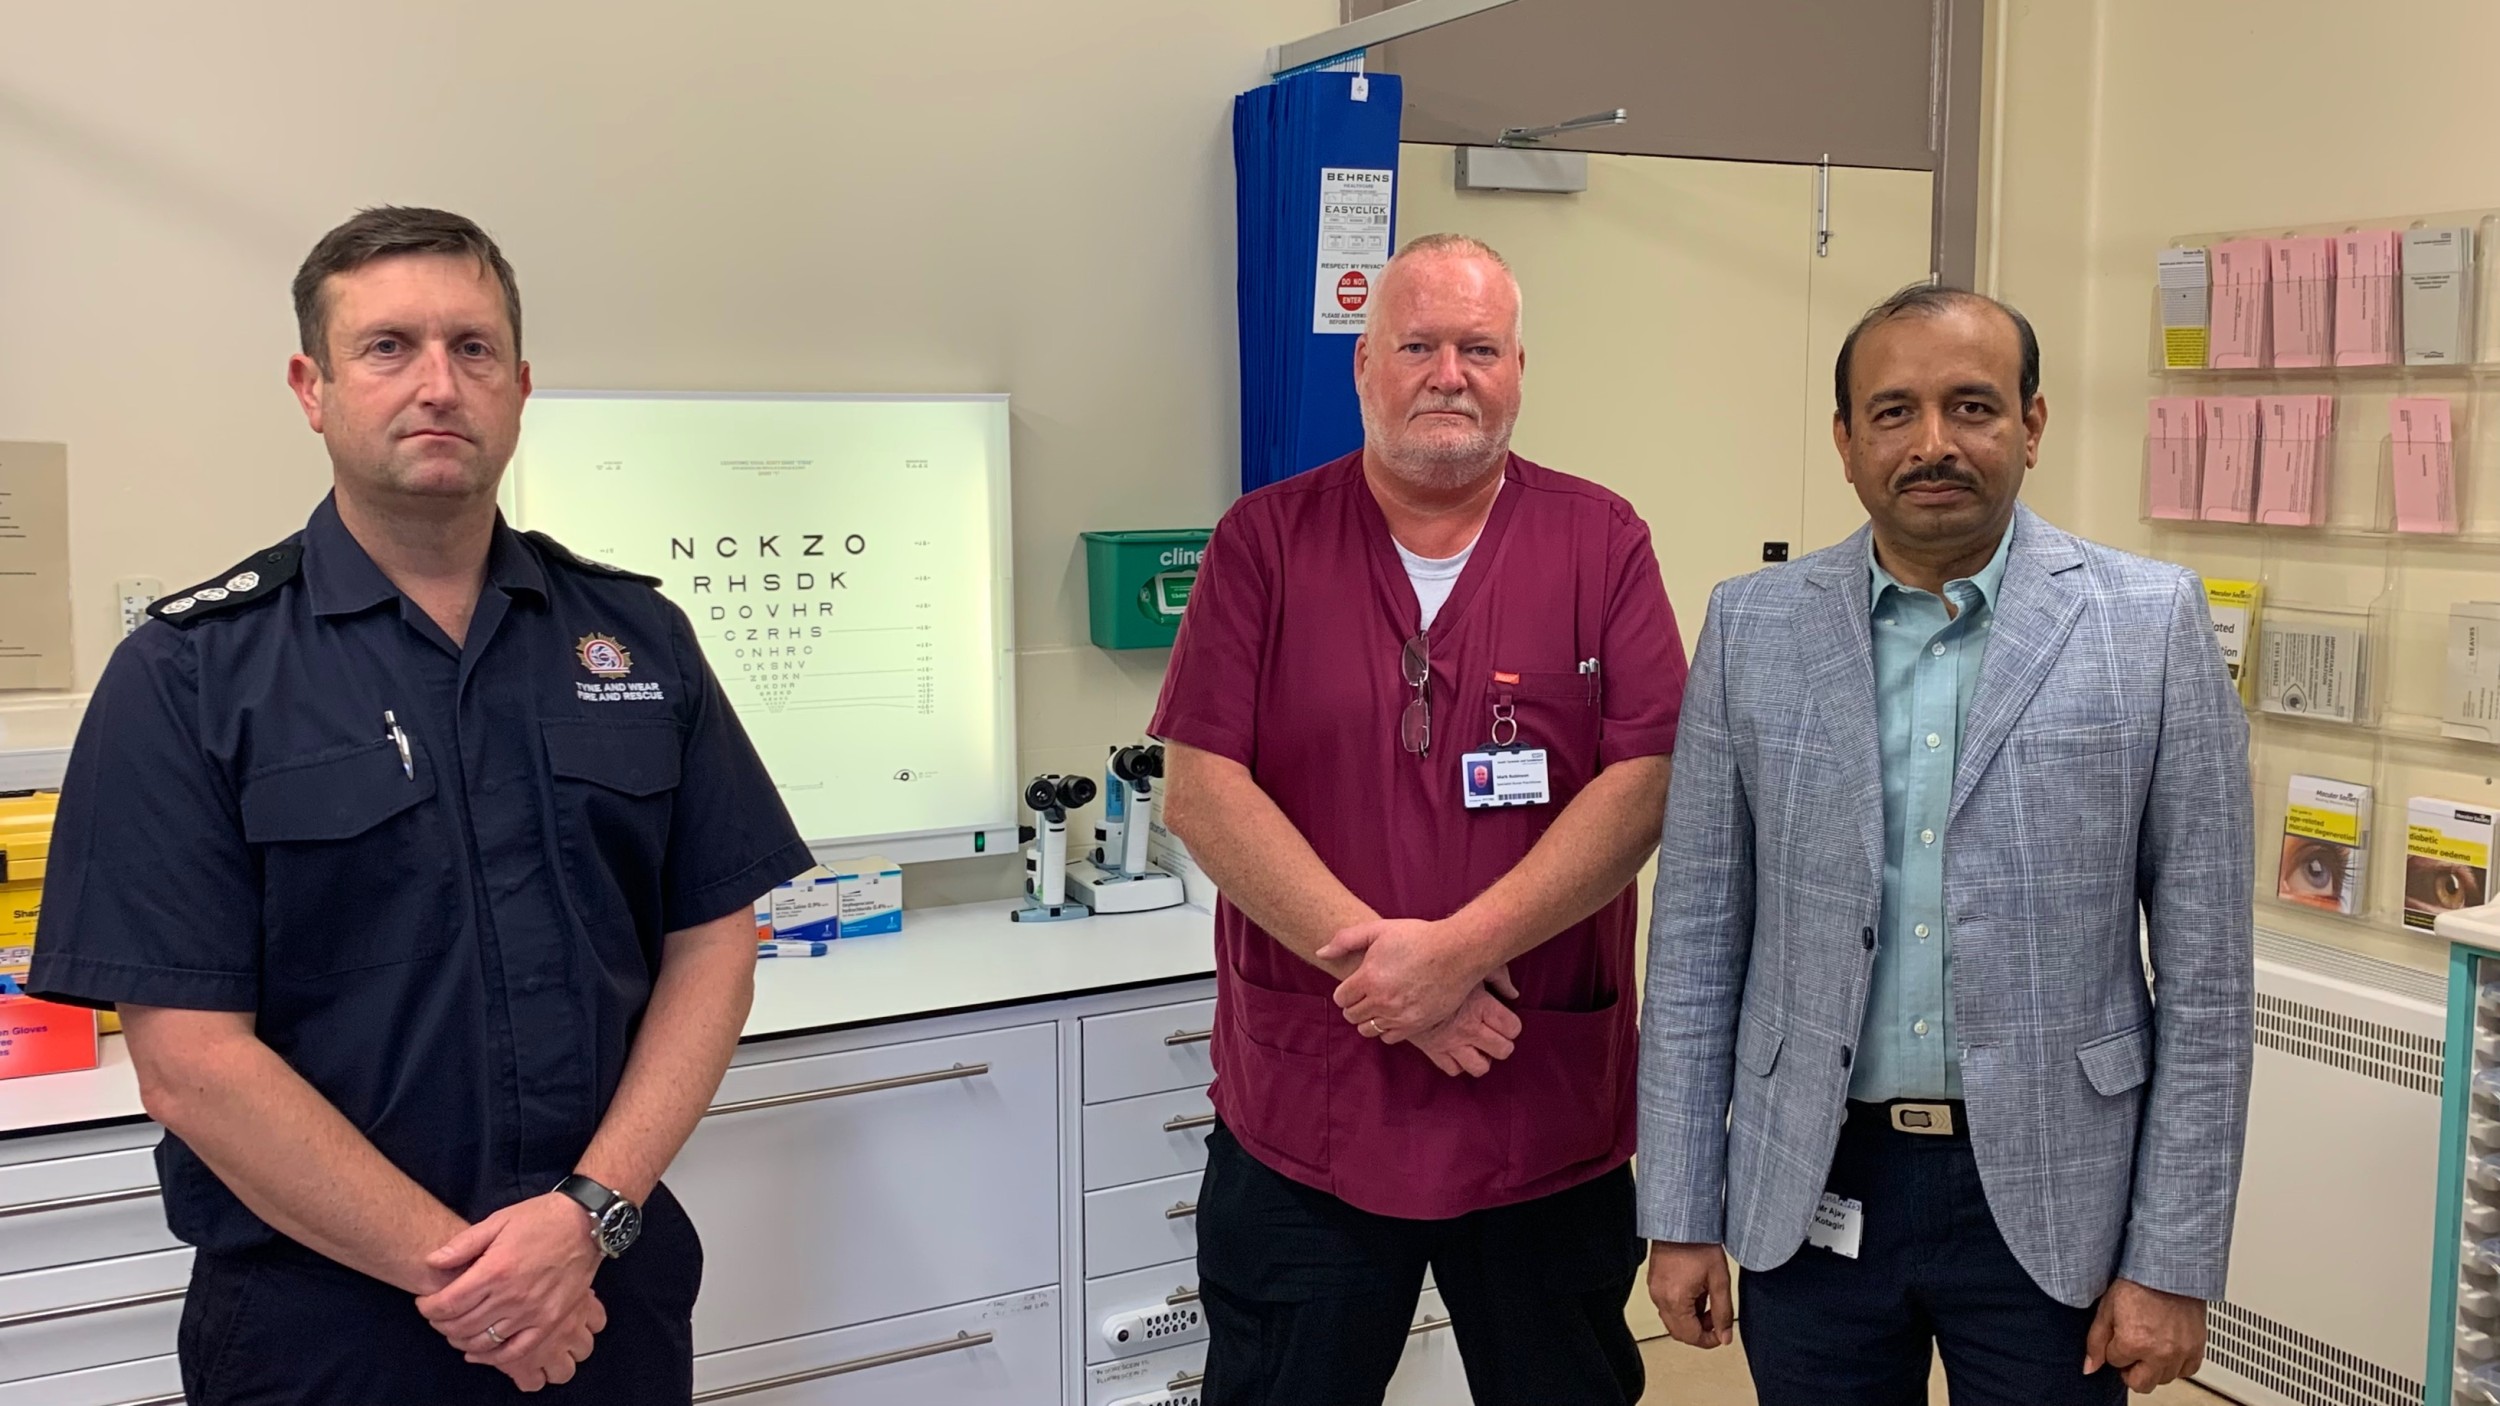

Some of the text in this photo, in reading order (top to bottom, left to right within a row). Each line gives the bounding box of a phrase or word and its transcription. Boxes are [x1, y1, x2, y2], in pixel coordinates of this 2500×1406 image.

[1327, 173, 1390, 182] BEHRENS
[1325, 206, 1386, 214] EASYCLICK
[1353, 278, 1365, 286] NOT
[1160, 548, 1206, 566] cline
[2212, 621, 2235, 634] ated
[576, 682, 660, 692] TYNE AND WEAR
[577, 690, 664, 701] FIRE AND RESCUE
[2316, 790, 2338, 798] Macular
[2289, 815, 2325, 827] age-related
[2314, 828, 2357, 841] degeneration
[2409, 833, 2439, 844] diabetic
[2408, 844, 2471, 861] macular oedema
[13, 909, 41, 919] Shar
[12, 1026, 48, 1035] Gloves
[1829, 1207, 1846, 1220] Ajay
[1815, 1215, 1845, 1231] Kotagiri
